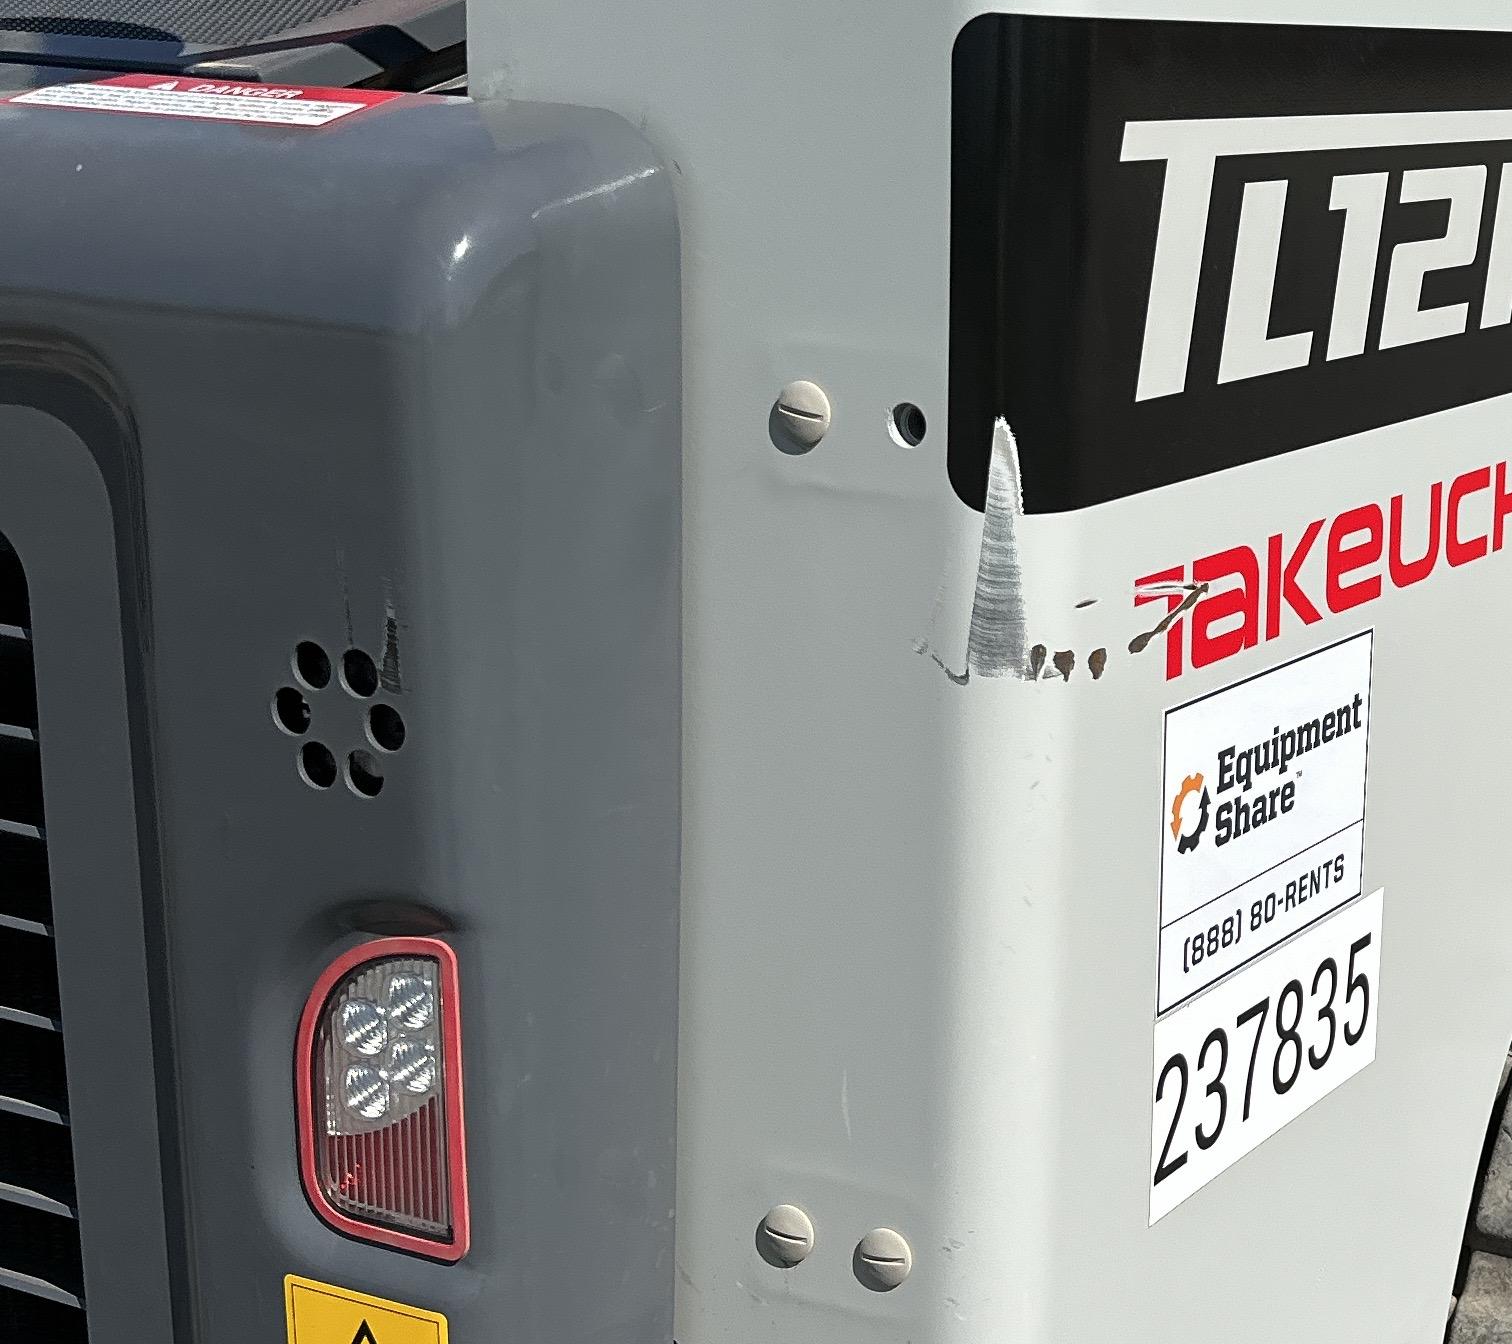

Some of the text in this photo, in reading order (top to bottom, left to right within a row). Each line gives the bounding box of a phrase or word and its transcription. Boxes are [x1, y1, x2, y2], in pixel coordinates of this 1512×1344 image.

[187, 83, 304, 99] DANGER
[1216, 692, 1363, 795] Equipment
[1214, 778, 1297, 848] Share
[1183, 852, 1346, 974] (888) 80-RENTS
[1153, 932, 1372, 1187] 237835
